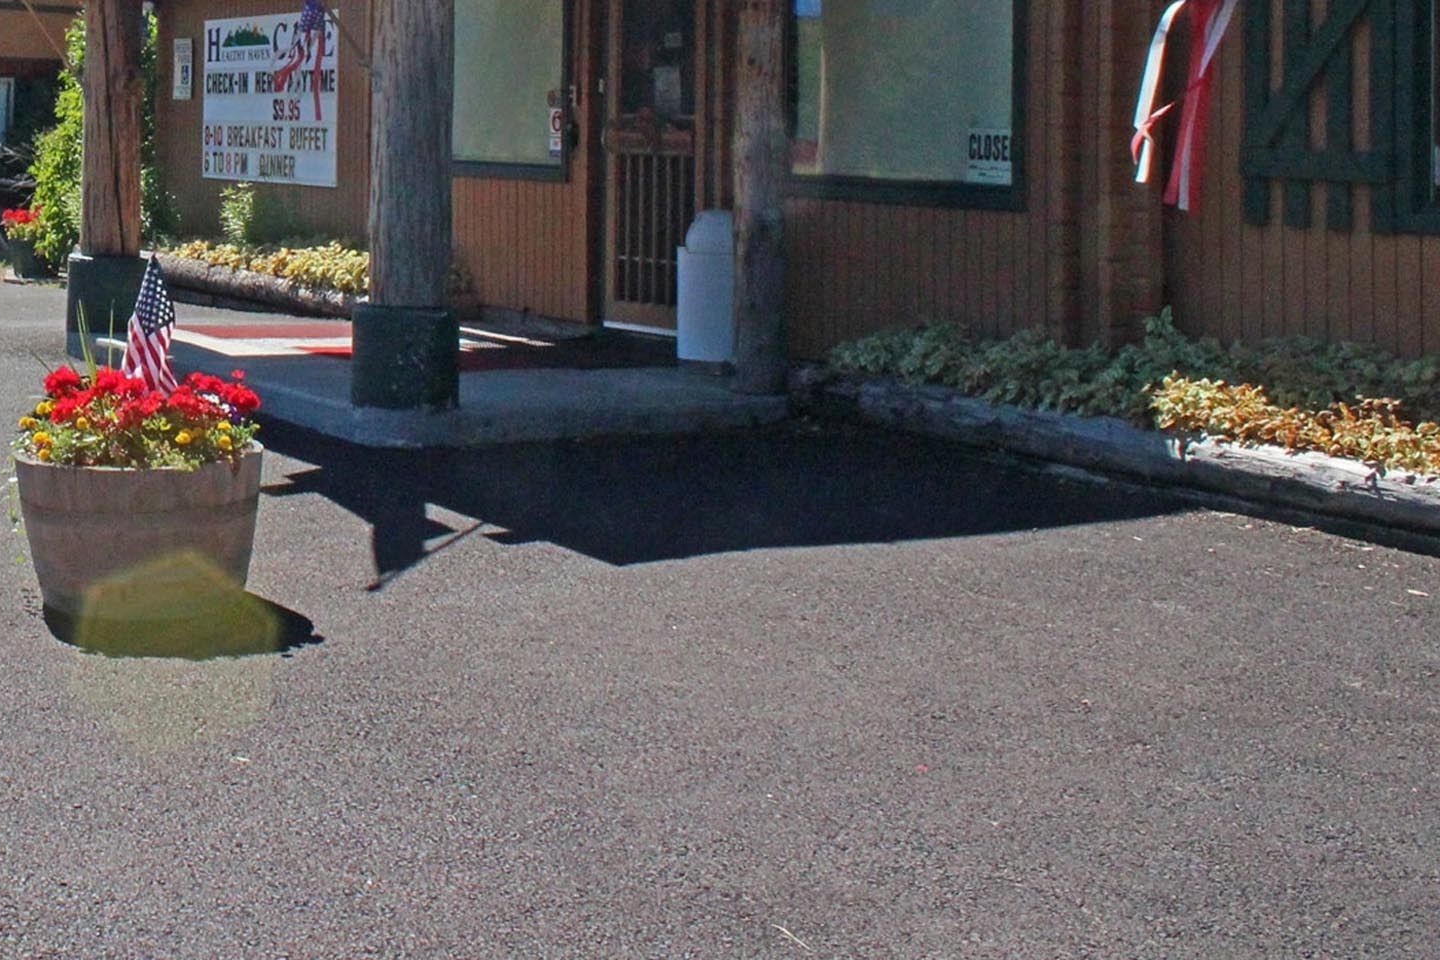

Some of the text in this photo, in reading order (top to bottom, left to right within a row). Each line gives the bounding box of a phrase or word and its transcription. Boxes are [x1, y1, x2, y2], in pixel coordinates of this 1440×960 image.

[206, 72, 249, 95] CHECK-IN
[227, 126, 283, 149] BREAKFAST
[289, 127, 328, 152] BUFFET
[234, 152, 248, 175] PM
